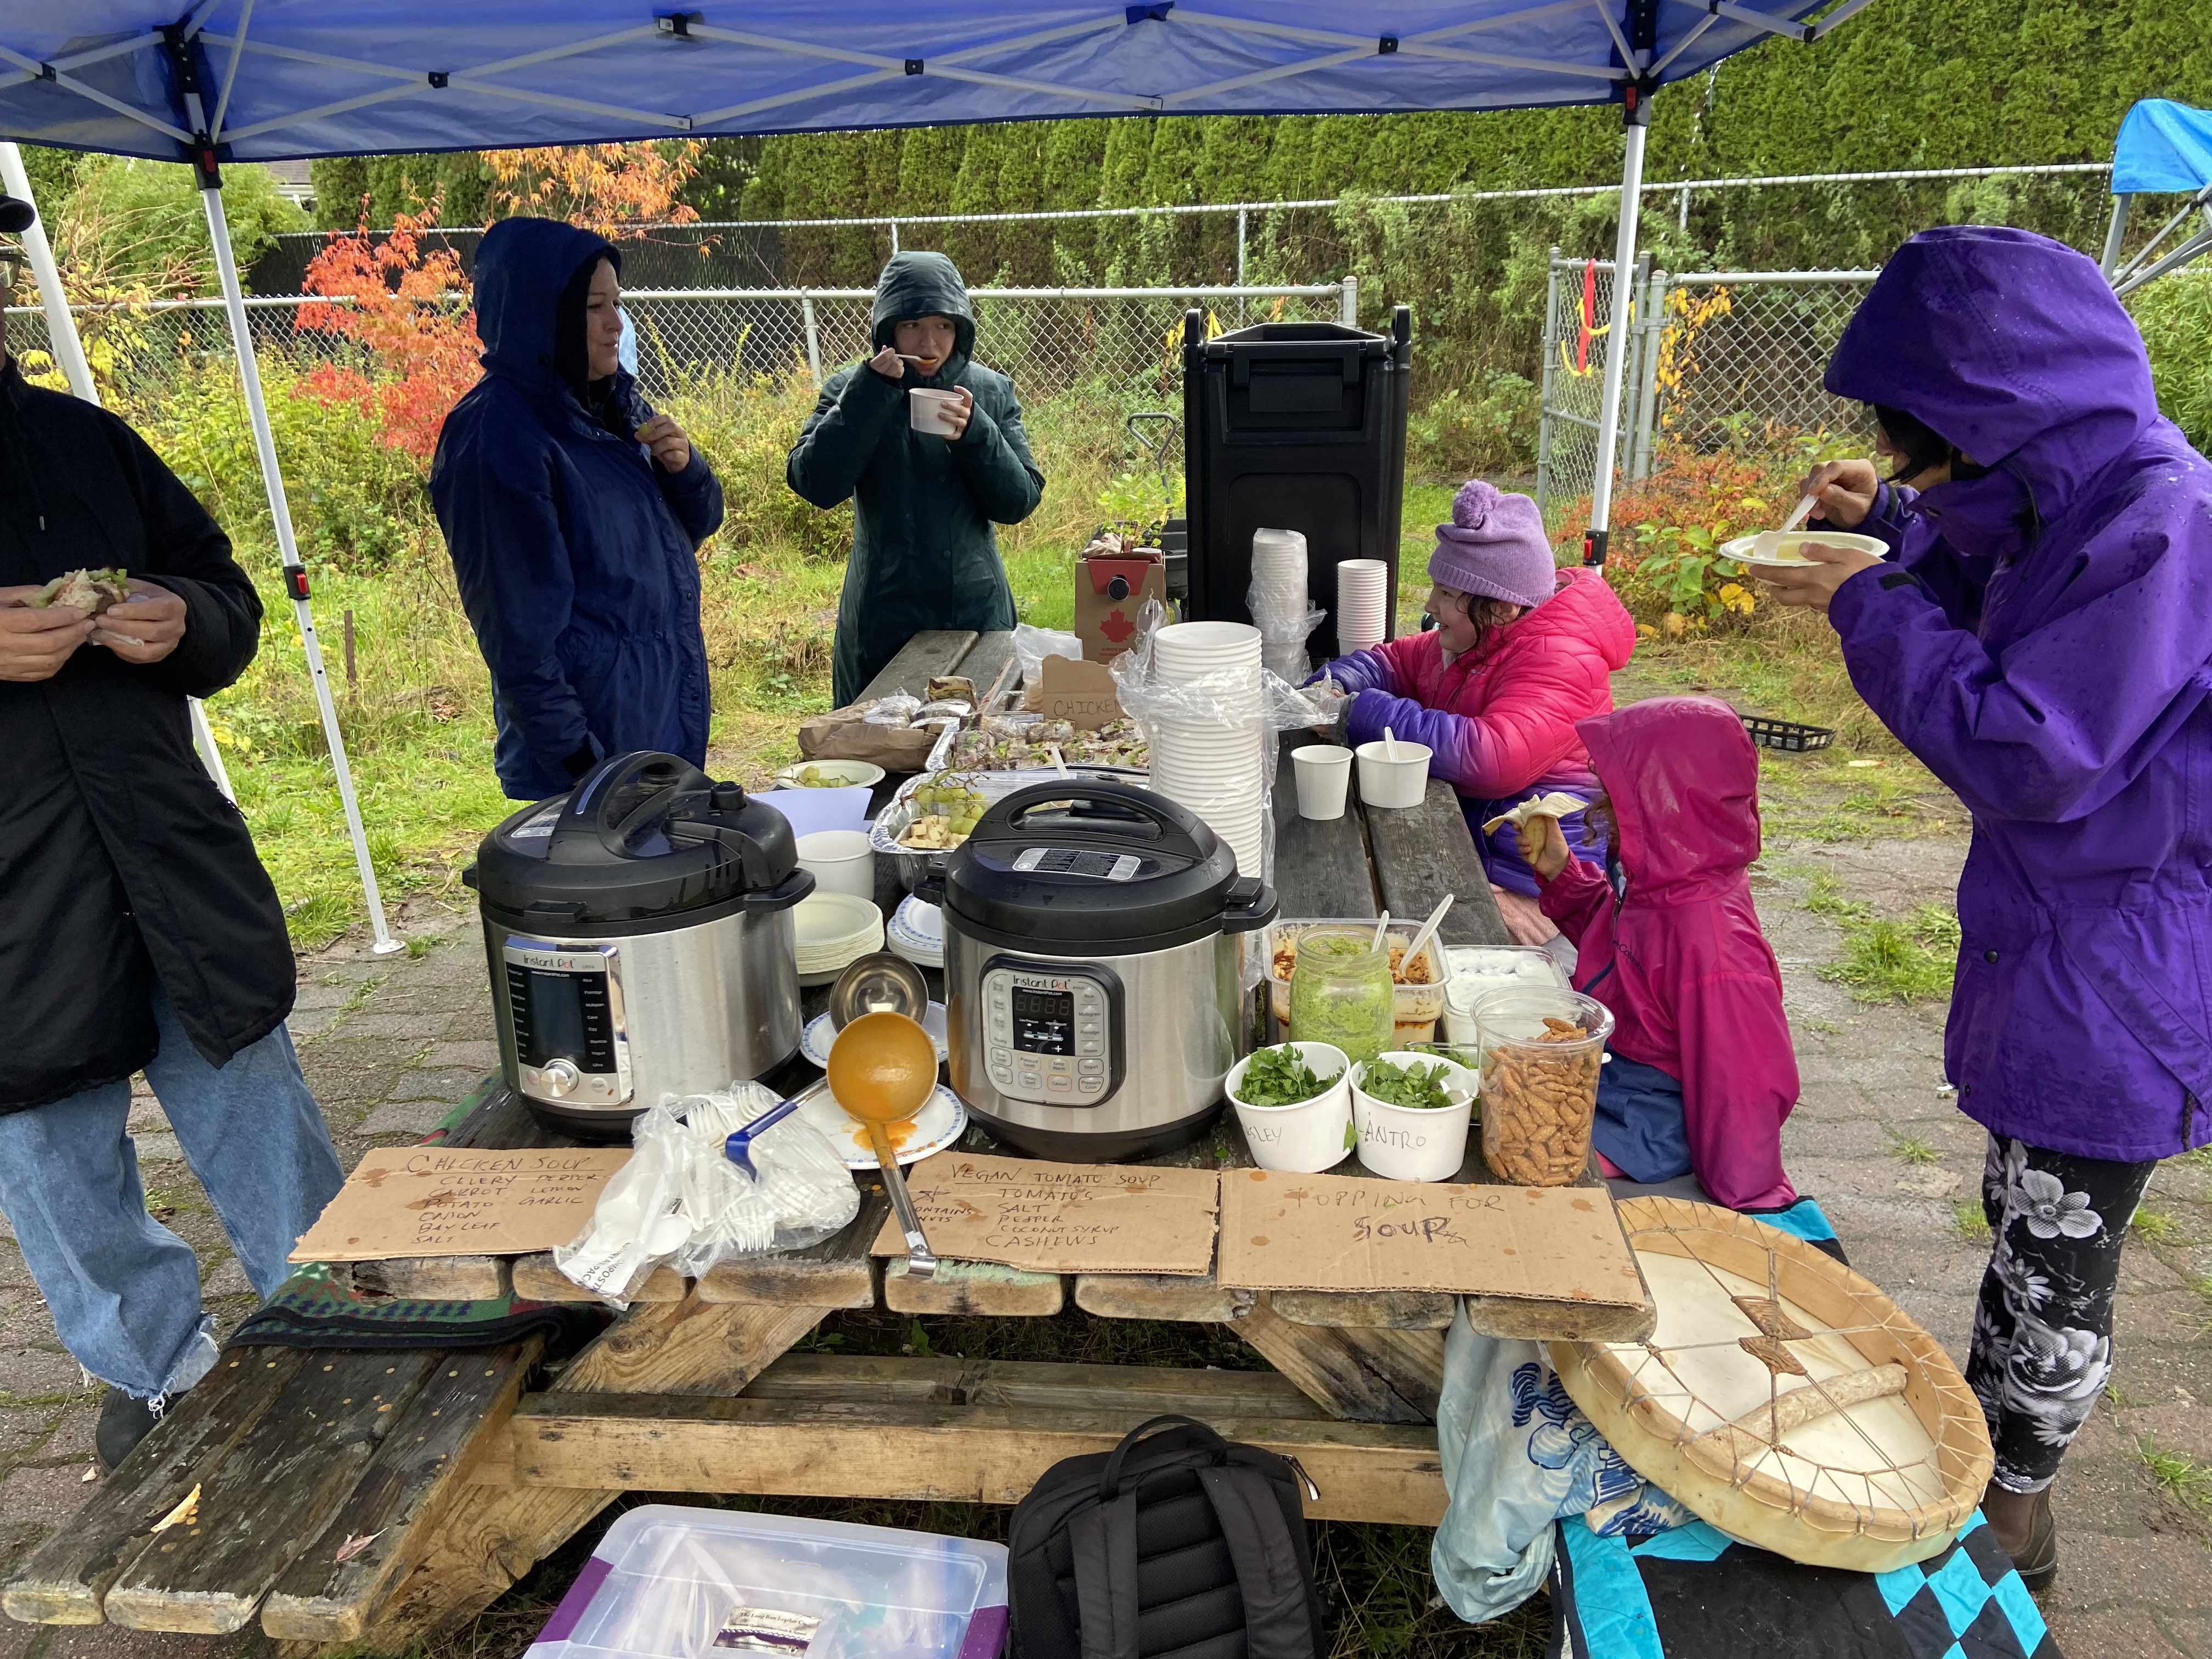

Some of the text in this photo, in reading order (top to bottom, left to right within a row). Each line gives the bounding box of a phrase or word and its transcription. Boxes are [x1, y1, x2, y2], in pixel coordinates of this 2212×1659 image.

[523, 954, 574, 969] Instant Pot
[1013, 974, 1047, 988] Instant
[1051, 979, 1068, 990] Pot
[408, 1154, 591, 1173] CHICKEN SOUP
[441, 1175, 517, 1186] CELERY
[952, 1163, 1022, 1183] VEGAN
[1034, 1173, 1104, 1185] TOMATO
[429, 1183, 588, 1198] CARROT LEMON
[424, 1196, 584, 1209] POTATO GARLIC
[1286, 1187, 1505, 1211] TOPPING FOR
[916, 1206, 972, 1216] ONTAINS
[997, 1202, 1051, 1214] SALT
[419, 1209, 482, 1222] ONION
[997, 1215, 1064, 1225] PEPPER
[418, 1222, 501, 1234] BAY LEAF
[1001, 1224, 1119, 1234] COCONUT SYRUP
[1352, 1216, 1451, 1244] SOUP
[411, 1235, 456, 1244] SALT
[985, 1234, 1098, 1248] CASHEWS
